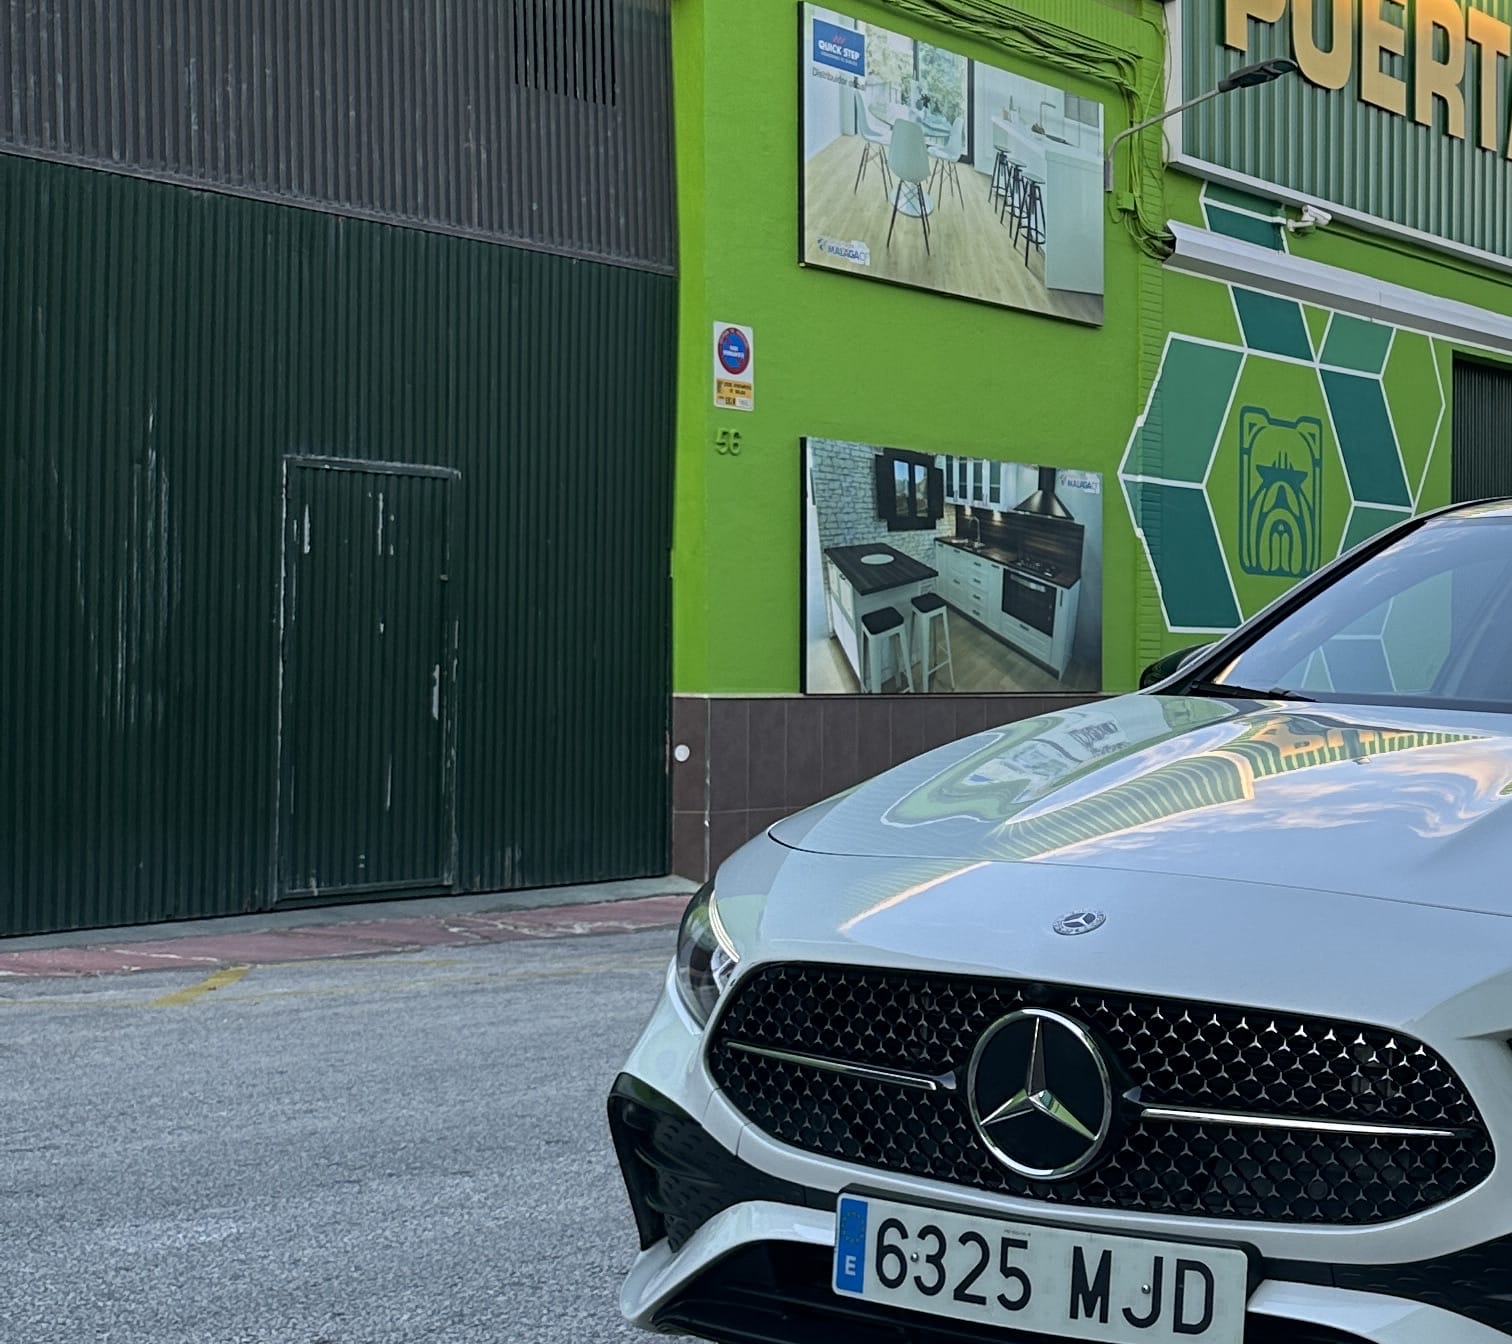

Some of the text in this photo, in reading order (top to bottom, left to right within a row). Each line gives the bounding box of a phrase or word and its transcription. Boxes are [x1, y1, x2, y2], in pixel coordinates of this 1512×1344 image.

[716, 427, 741, 456] 56
[844, 1256, 856, 1276] E
[875, 1218, 1214, 1336] 6325 MJD
